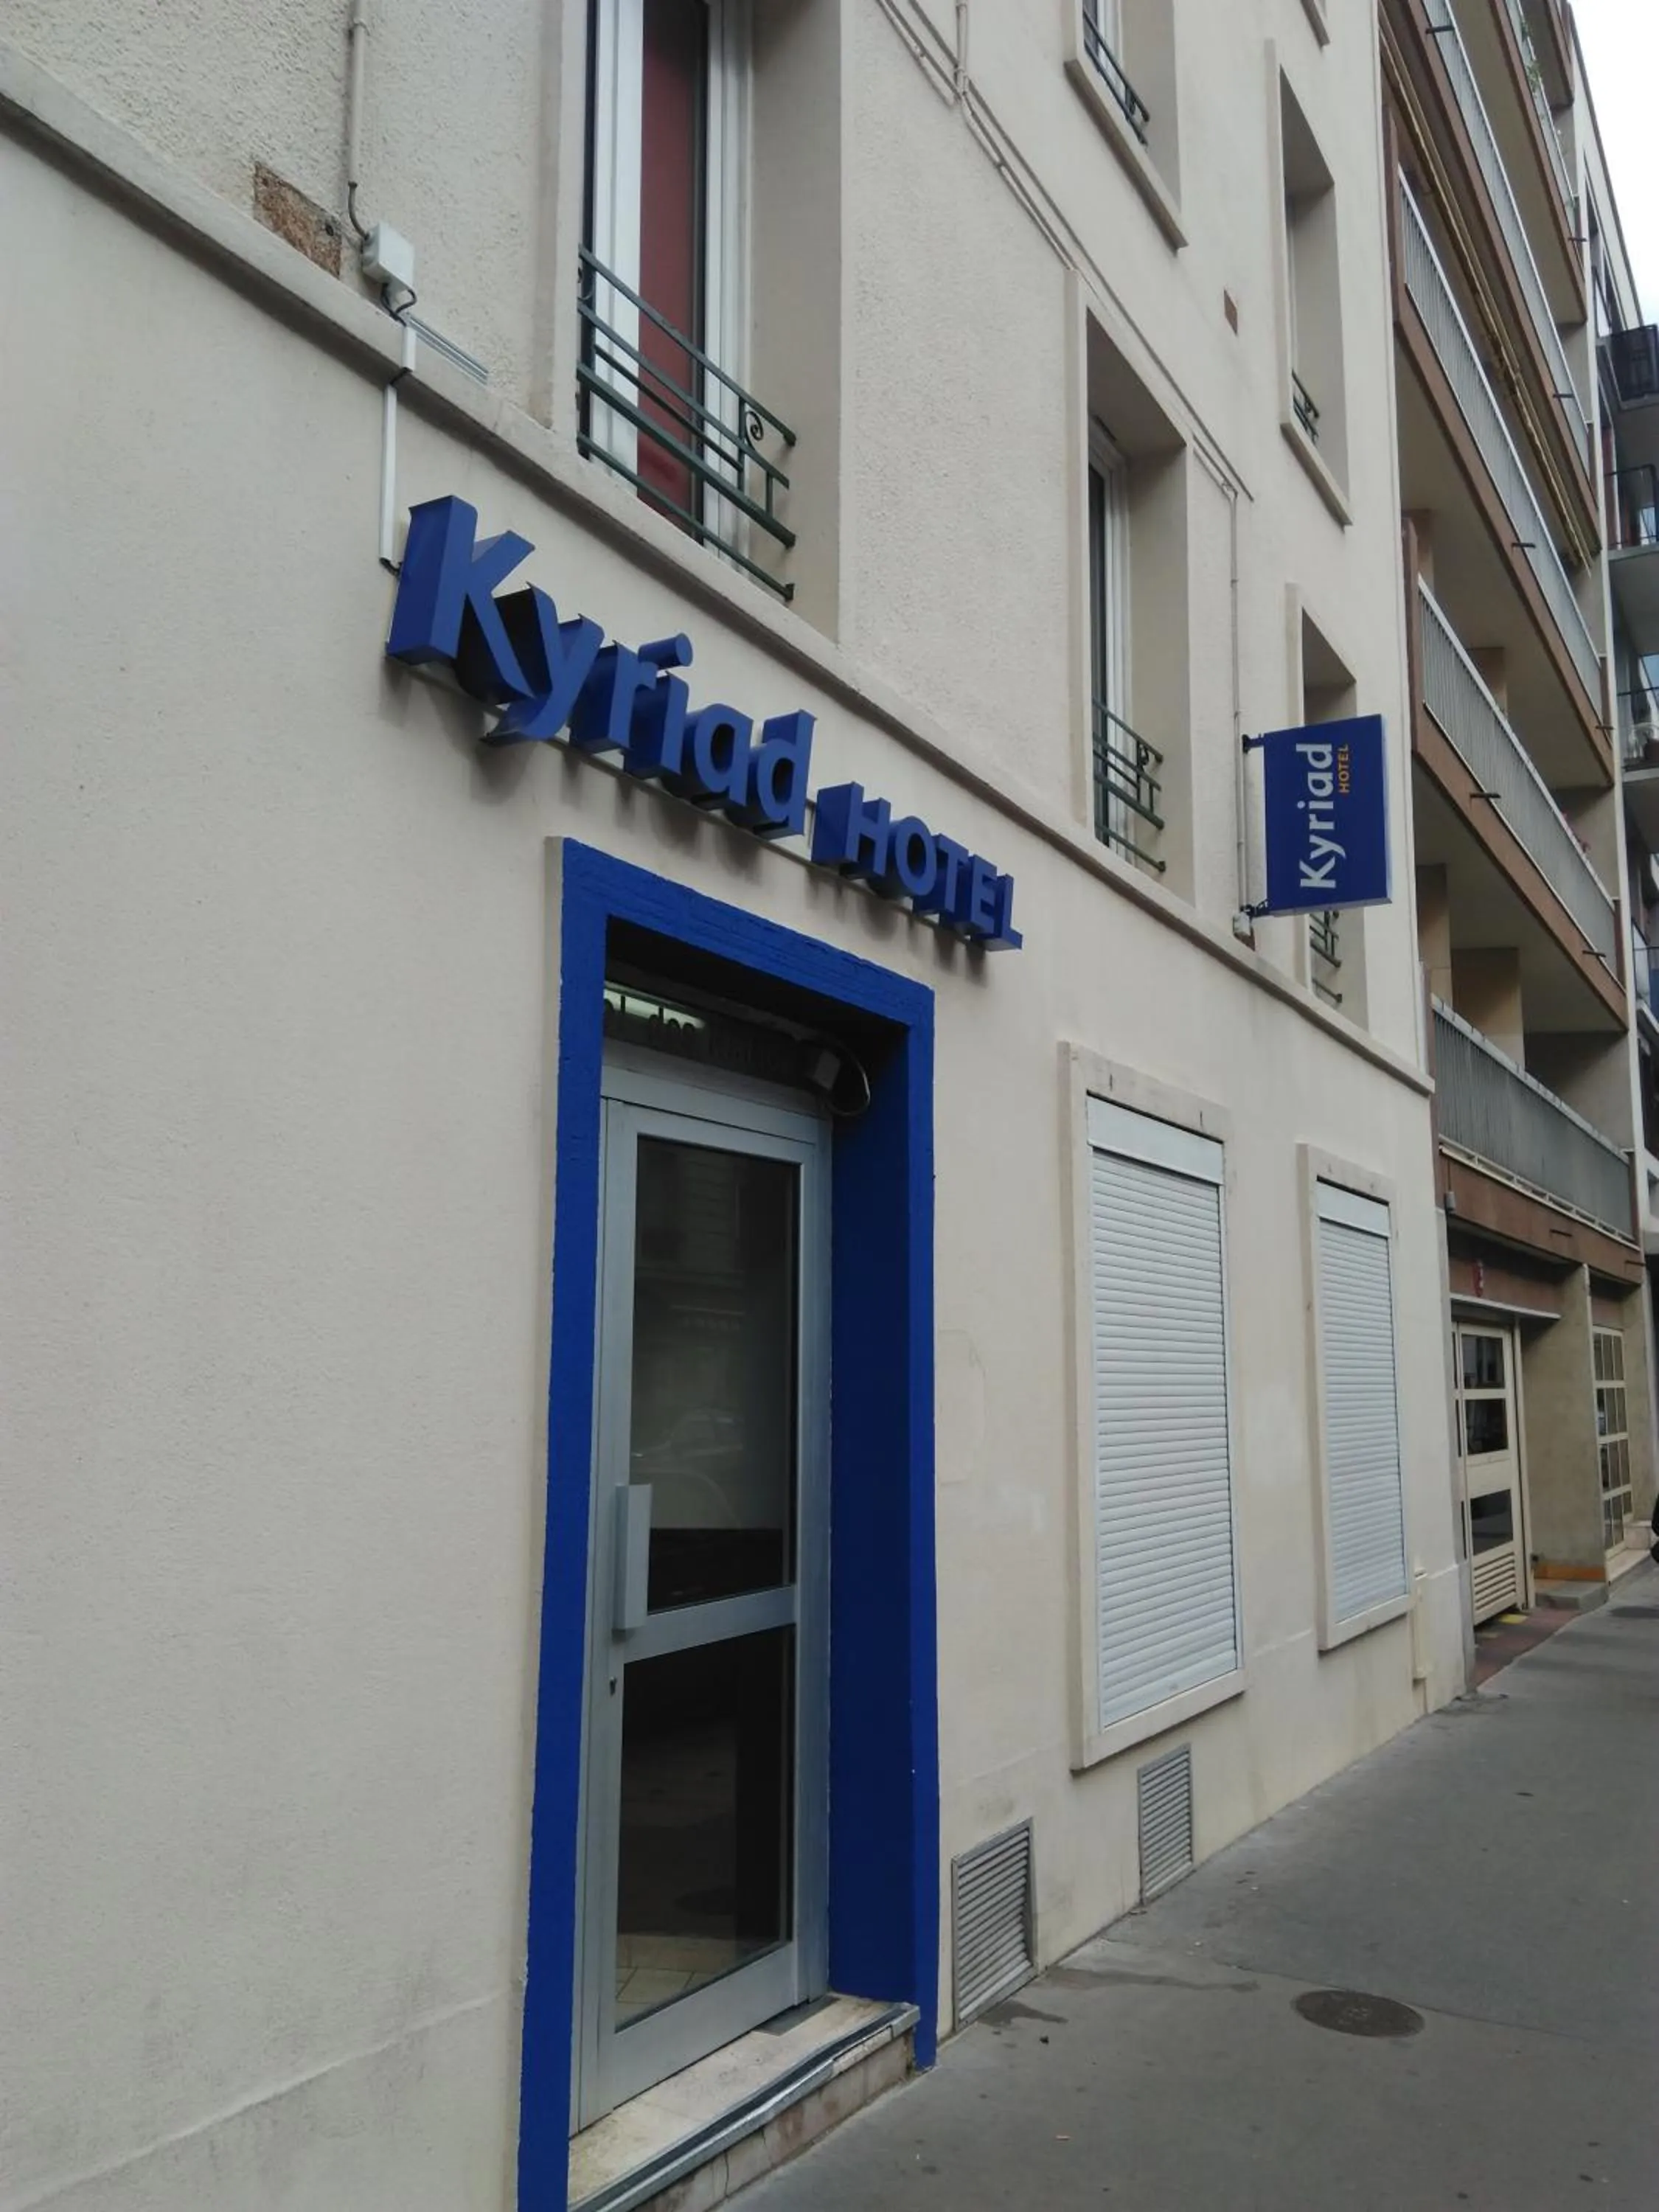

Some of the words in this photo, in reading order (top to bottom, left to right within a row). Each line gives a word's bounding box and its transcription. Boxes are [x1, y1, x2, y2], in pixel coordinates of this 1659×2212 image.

[386, 495, 817, 839] Kyriad
[811, 782, 1023, 951] HOTEL
[1338, 744, 1350, 793] HOTEL
[1295, 743, 1346, 888] Kyriad
